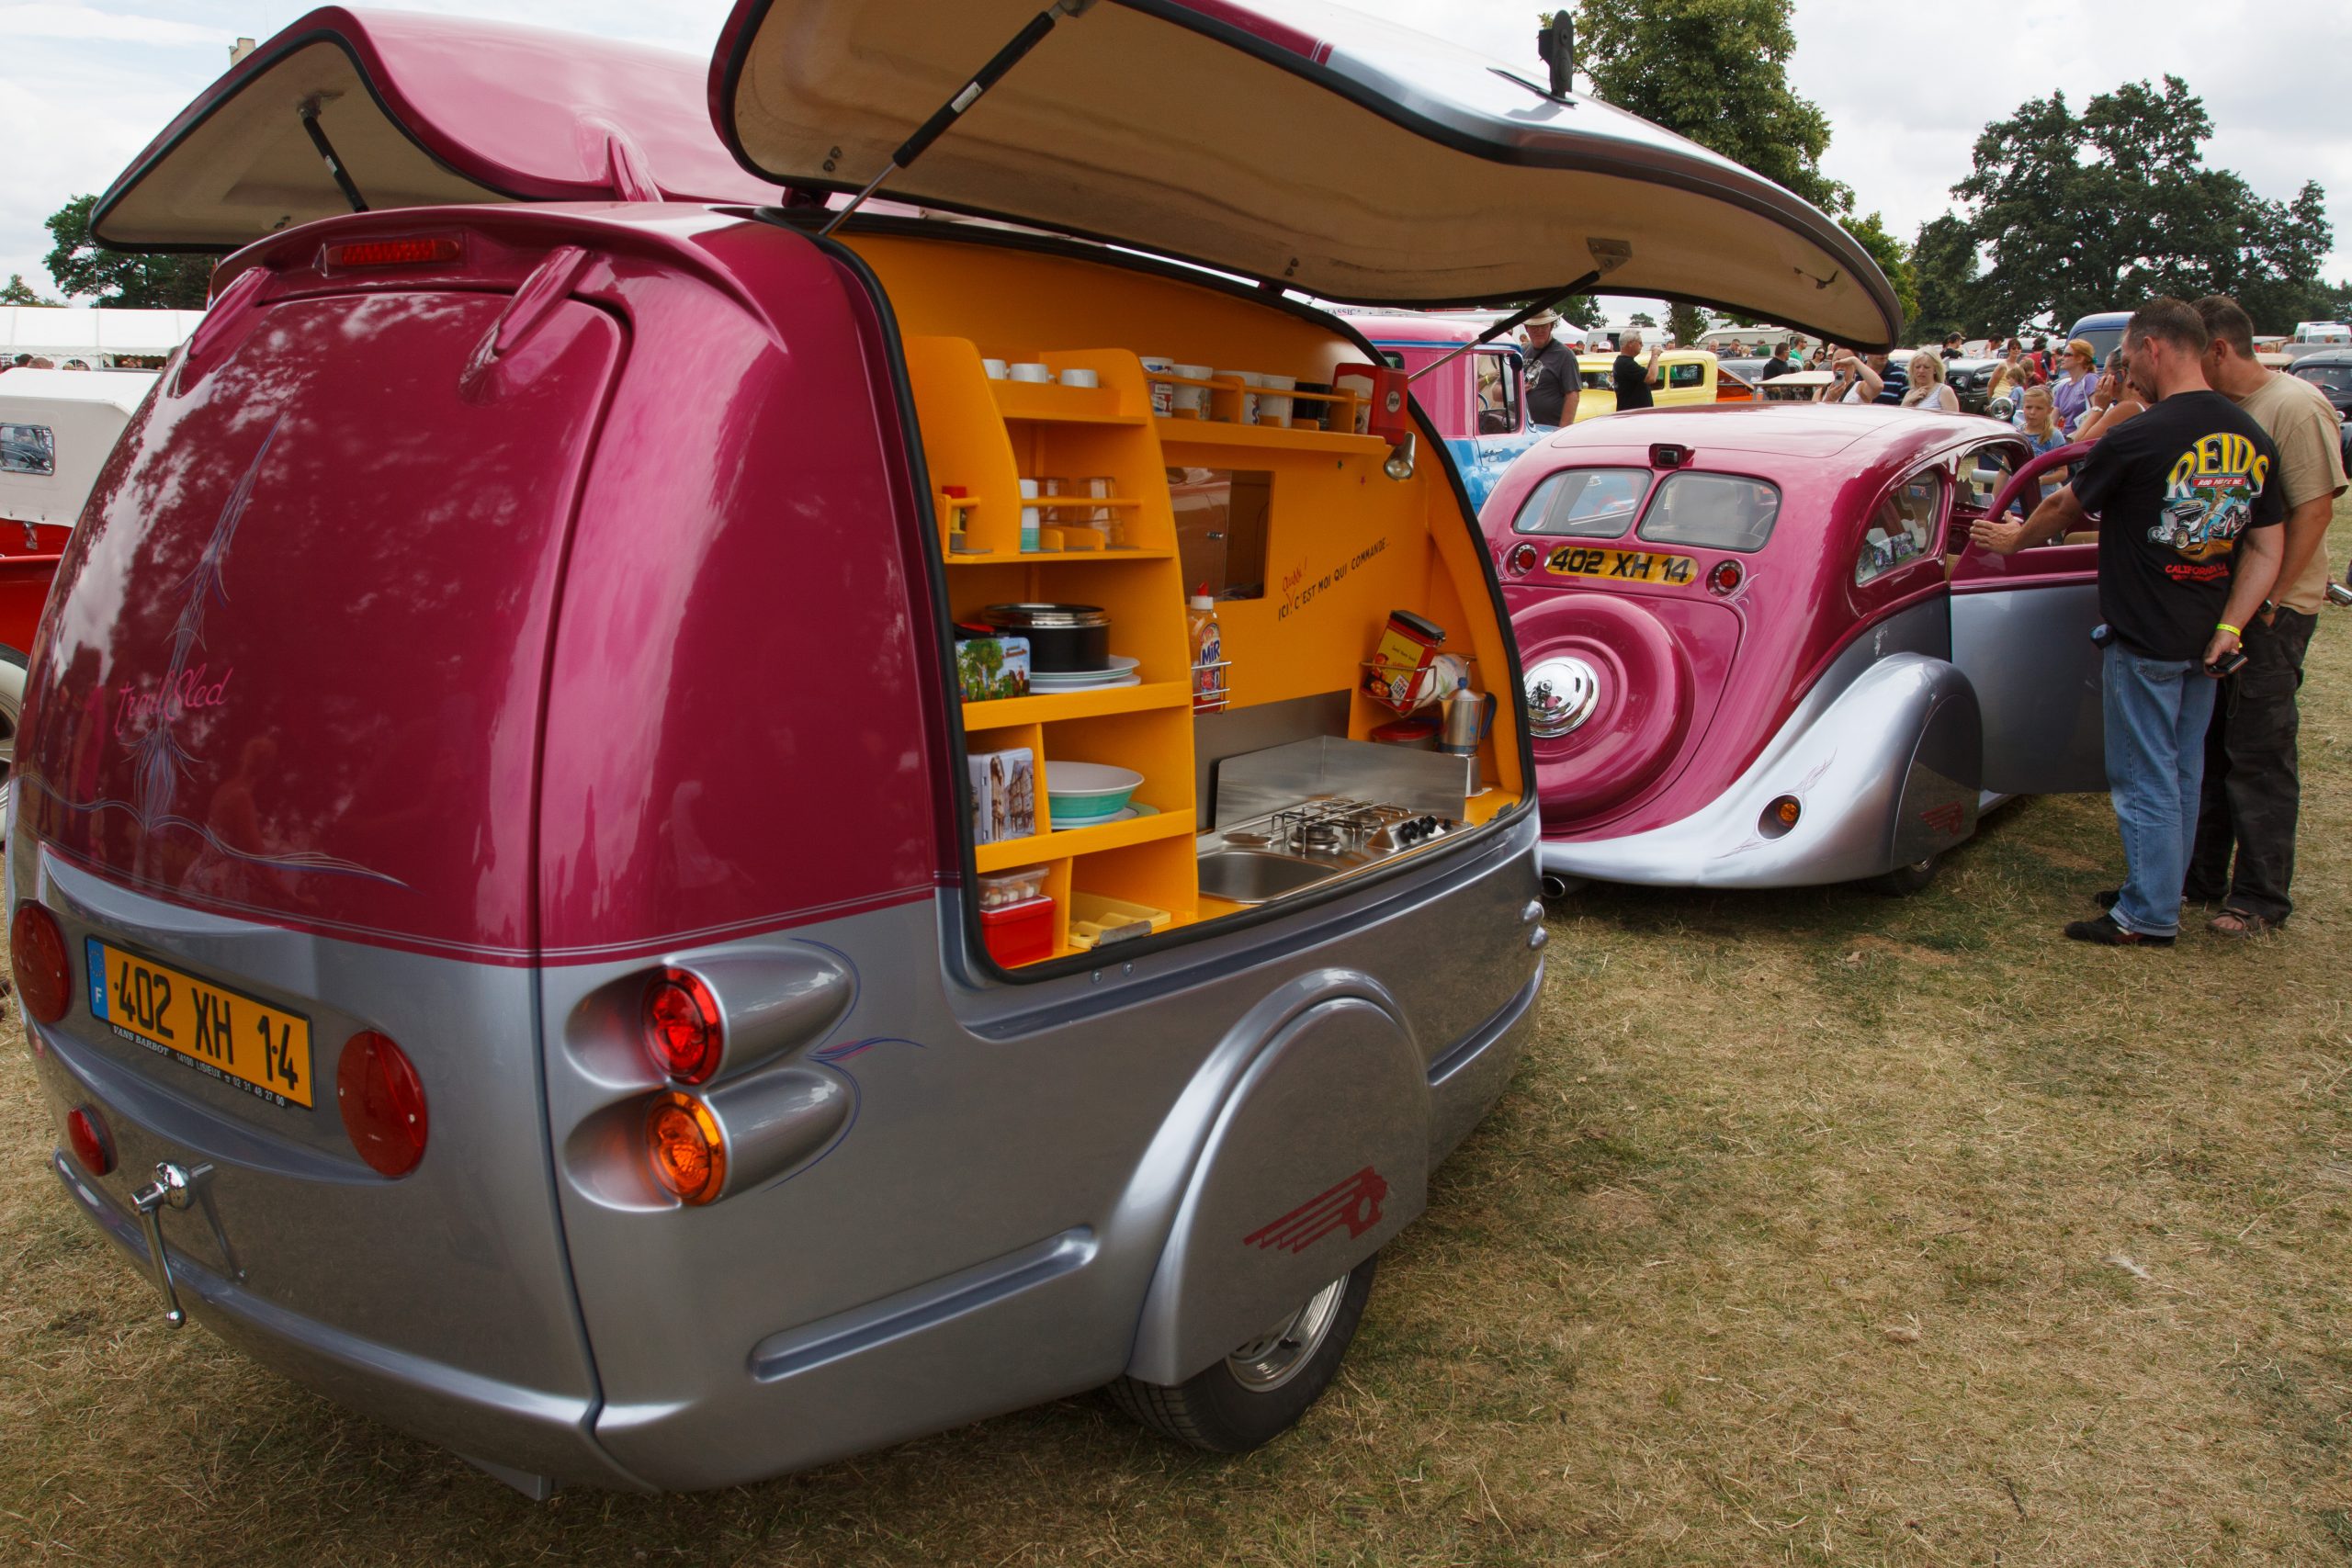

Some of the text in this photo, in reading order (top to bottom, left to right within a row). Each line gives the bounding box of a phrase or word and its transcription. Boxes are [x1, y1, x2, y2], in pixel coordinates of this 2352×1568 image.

[2163, 433, 2269, 500] REIDS
[1317, 574, 1331, 593] MOI
[1333, 562, 1348, 581] QUI
[1552, 547, 1690, 582] 402 XH 14
[94, 986, 103, 1004] F
[112, 1024, 170, 1056] VANS BARBOT
[119, 961, 300, 1091] 402 XH 14
[196, 1060, 221, 1079] LISIEUX
[232, 1076, 242, 1089] 02
[243, 1080, 252, 1092] 31
[265, 1089, 274, 1101] 27
